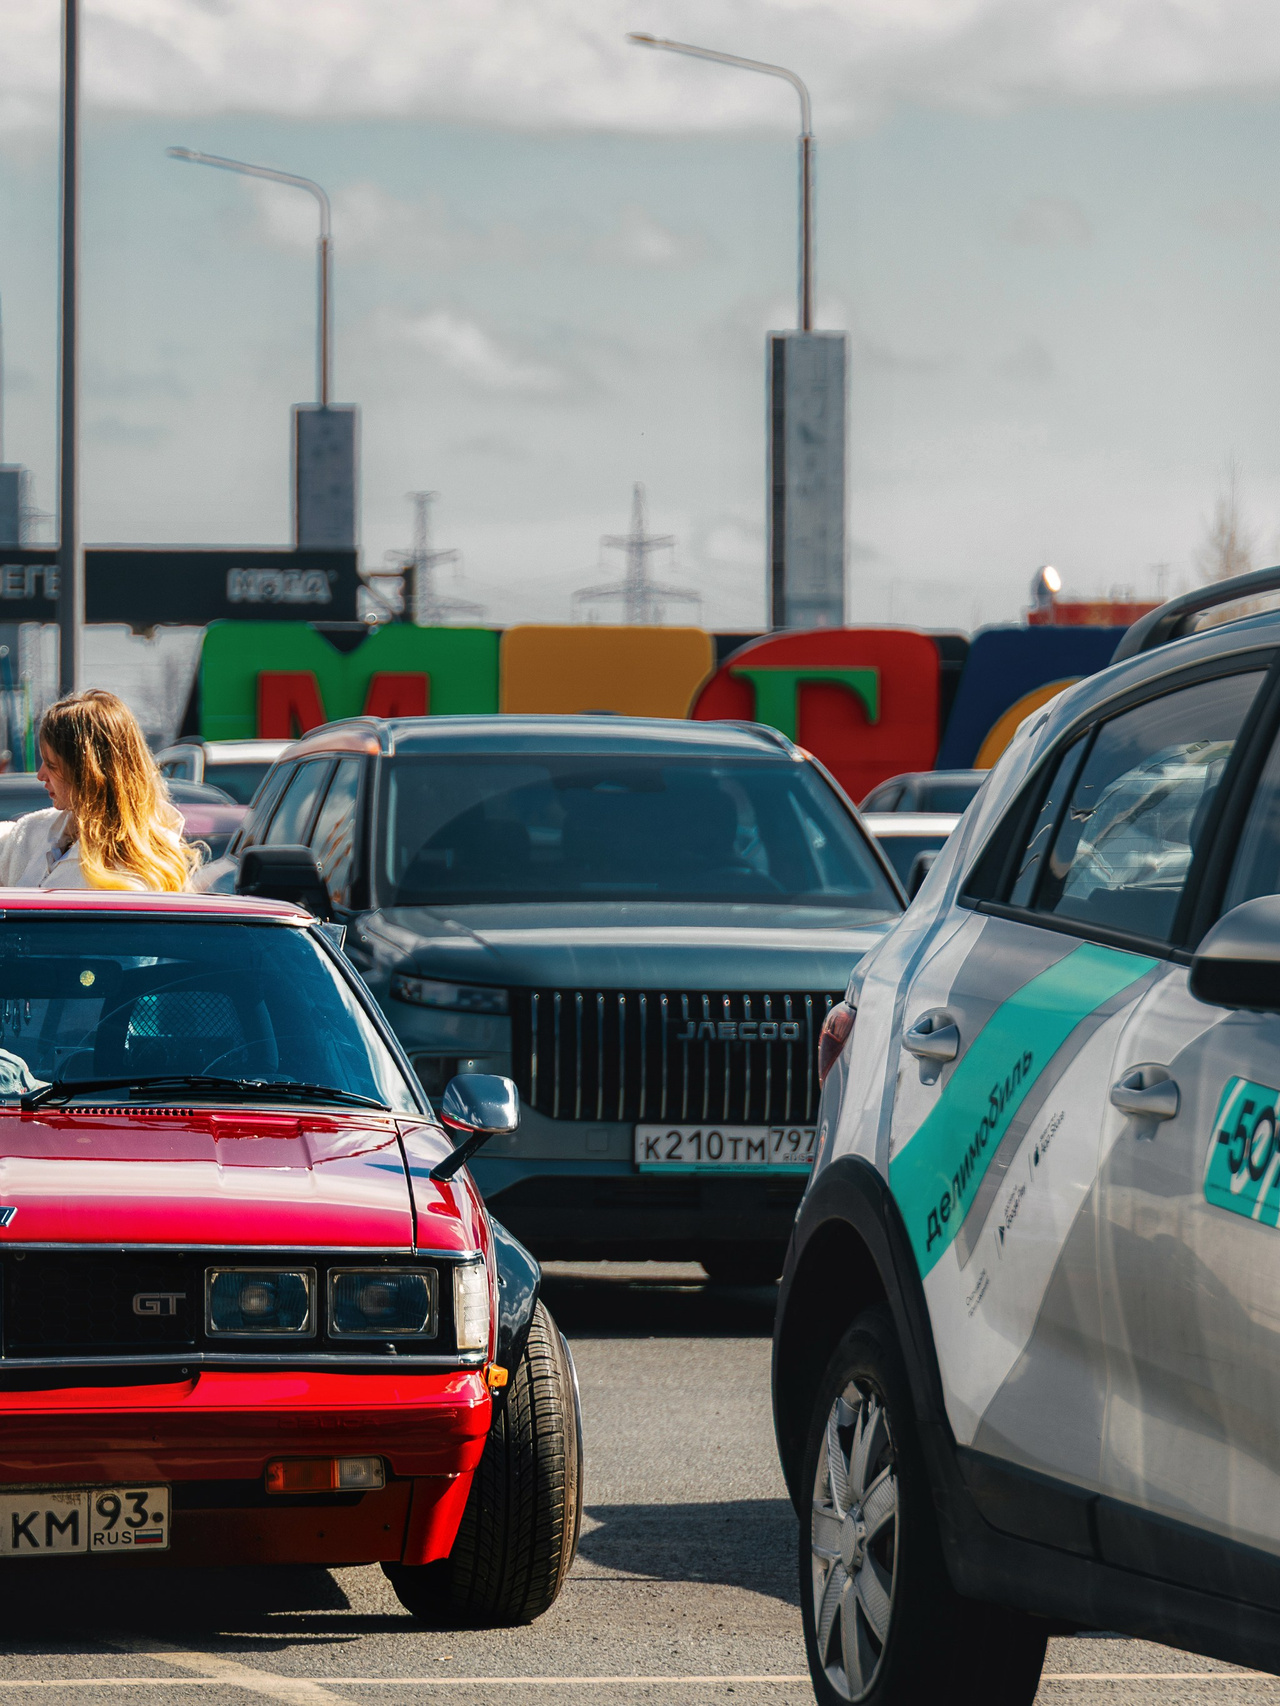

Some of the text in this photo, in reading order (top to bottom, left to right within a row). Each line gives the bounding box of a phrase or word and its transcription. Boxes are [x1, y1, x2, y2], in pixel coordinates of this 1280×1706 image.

[132, 1292, 186, 1316] GT
[95, 1491, 149, 1530] 93
[93, 1531, 132, 1546] RUS
